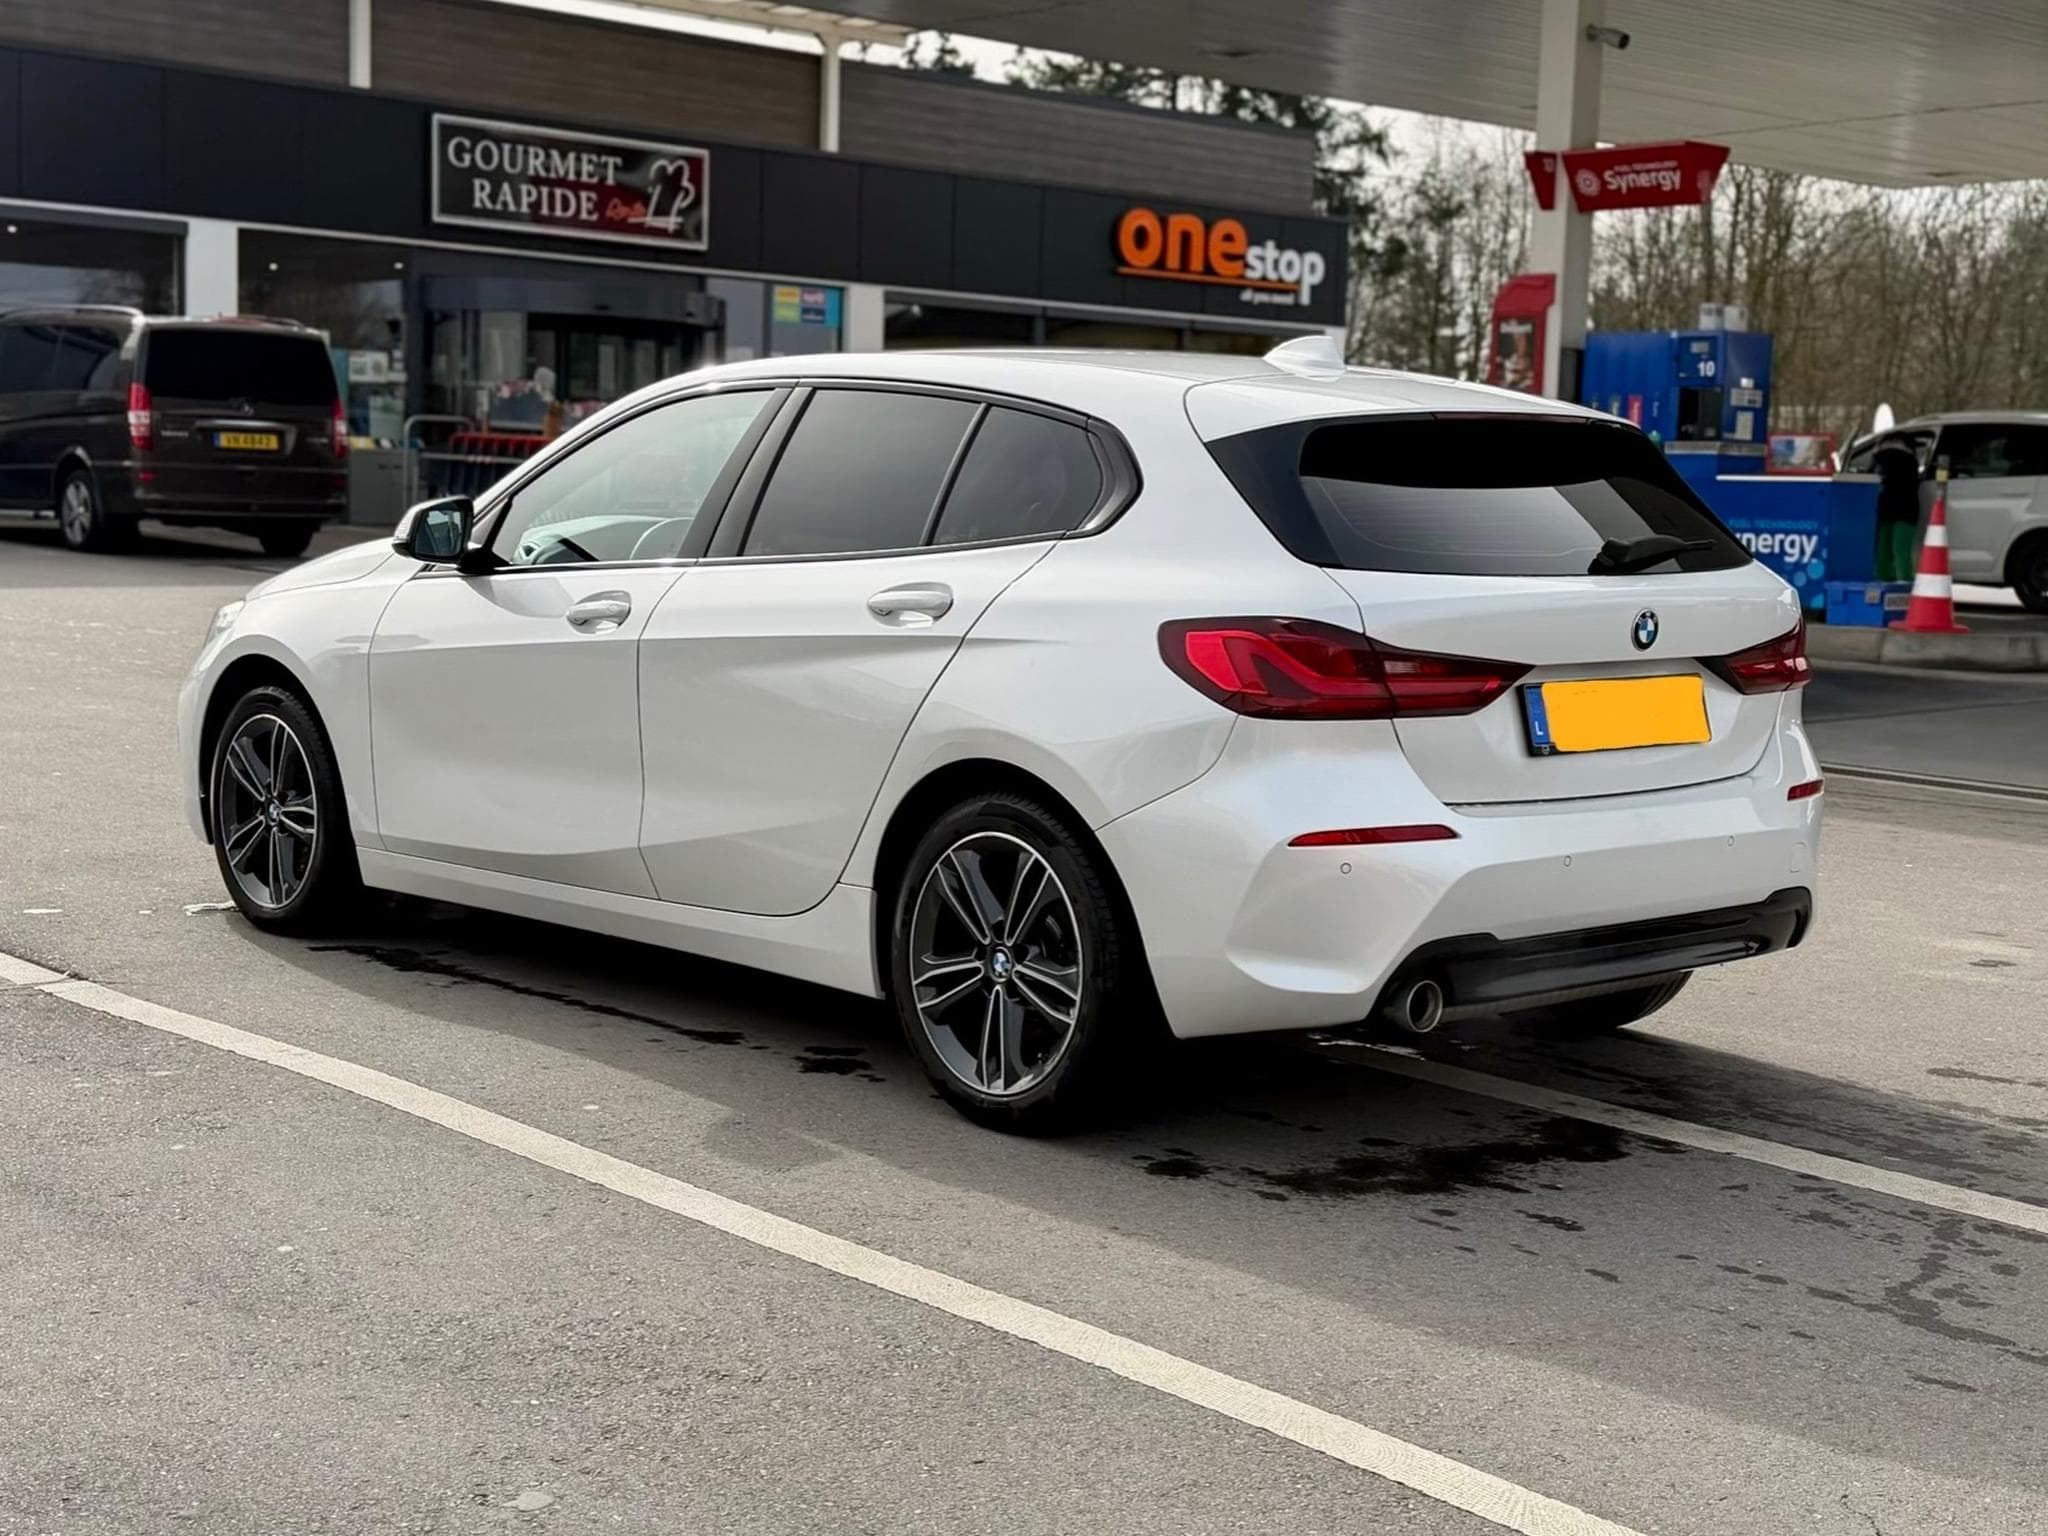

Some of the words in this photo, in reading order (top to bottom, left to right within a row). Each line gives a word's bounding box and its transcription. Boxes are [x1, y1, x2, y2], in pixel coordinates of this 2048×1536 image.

[447, 136, 623, 186] GOURMET
[1603, 169, 1681, 195] Synergy
[472, 178, 599, 221] RAPIDE
[1697, 360, 1716, 377] 10
[1735, 532, 1819, 563] nergy
[1534, 720, 1544, 736] L
